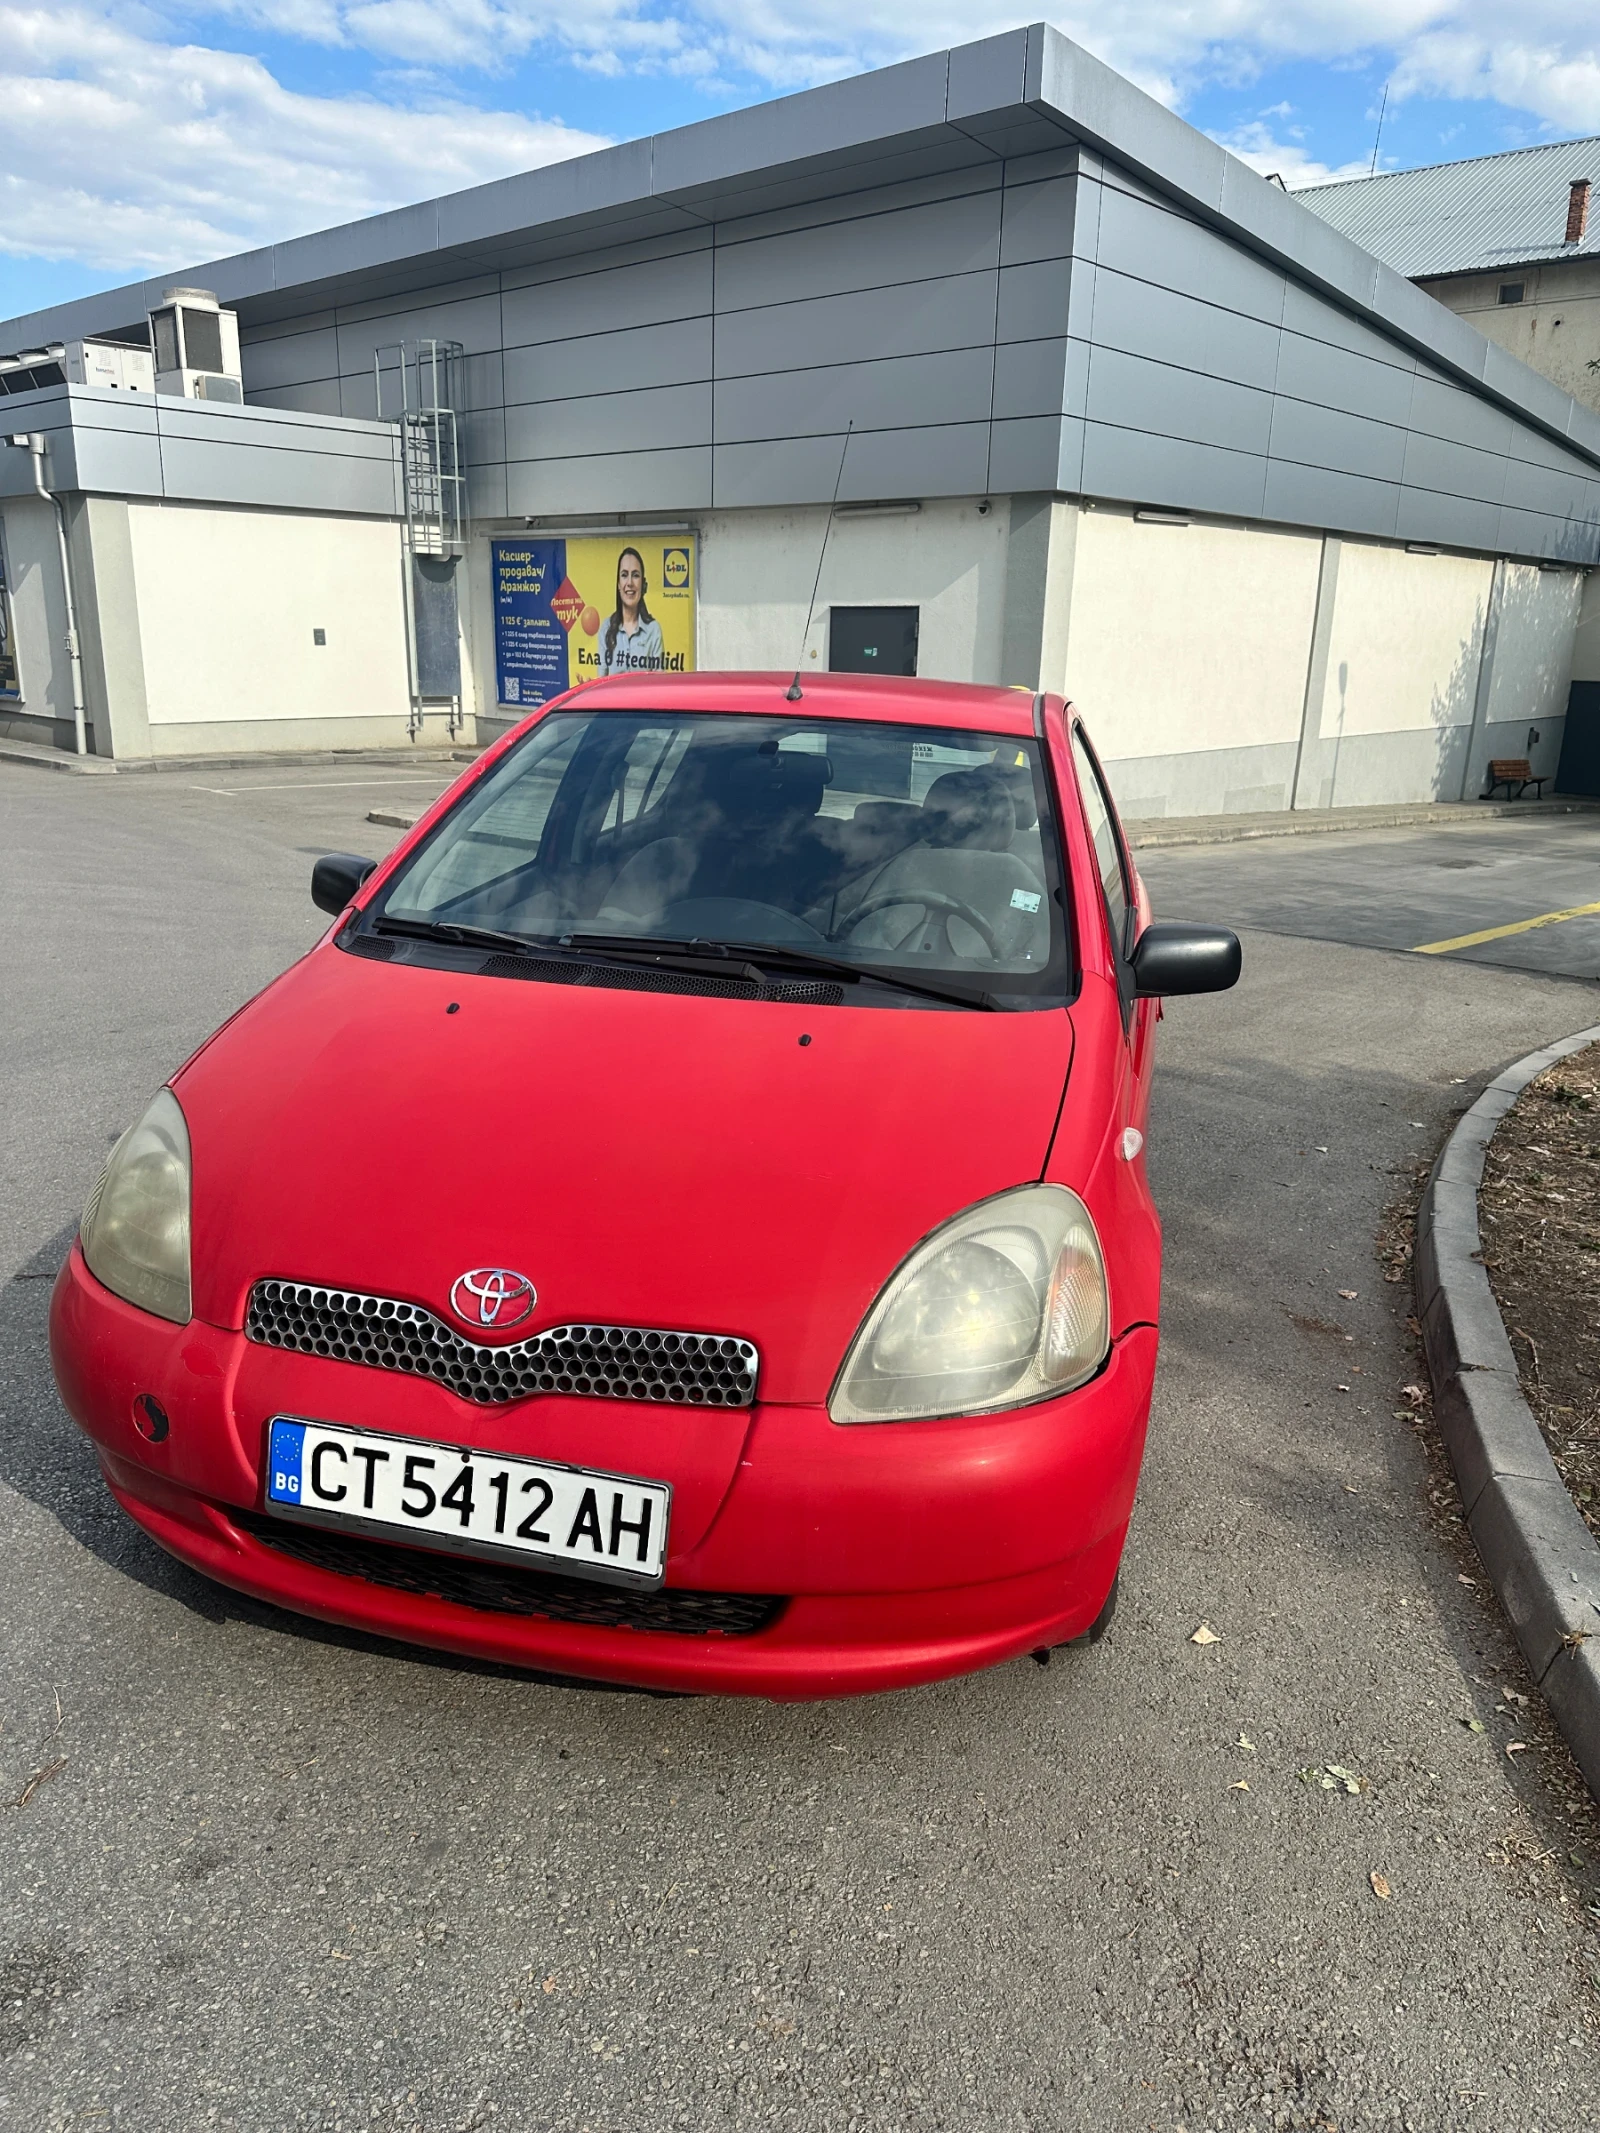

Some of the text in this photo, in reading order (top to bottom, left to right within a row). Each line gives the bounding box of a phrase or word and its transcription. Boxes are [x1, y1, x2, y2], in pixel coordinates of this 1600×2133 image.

[499, 549, 535, 564] Касиер-
[499, 563, 546, 579] продавач/
[500, 580, 541, 595] Аранжор
[556, 605, 579, 624] тук
[523, 619, 550, 628] заплата
[578, 647, 601, 666] Ела
[616, 649, 685, 672] #teamlidl
[275, 1440, 653, 1562] BG CT 5412 AH
